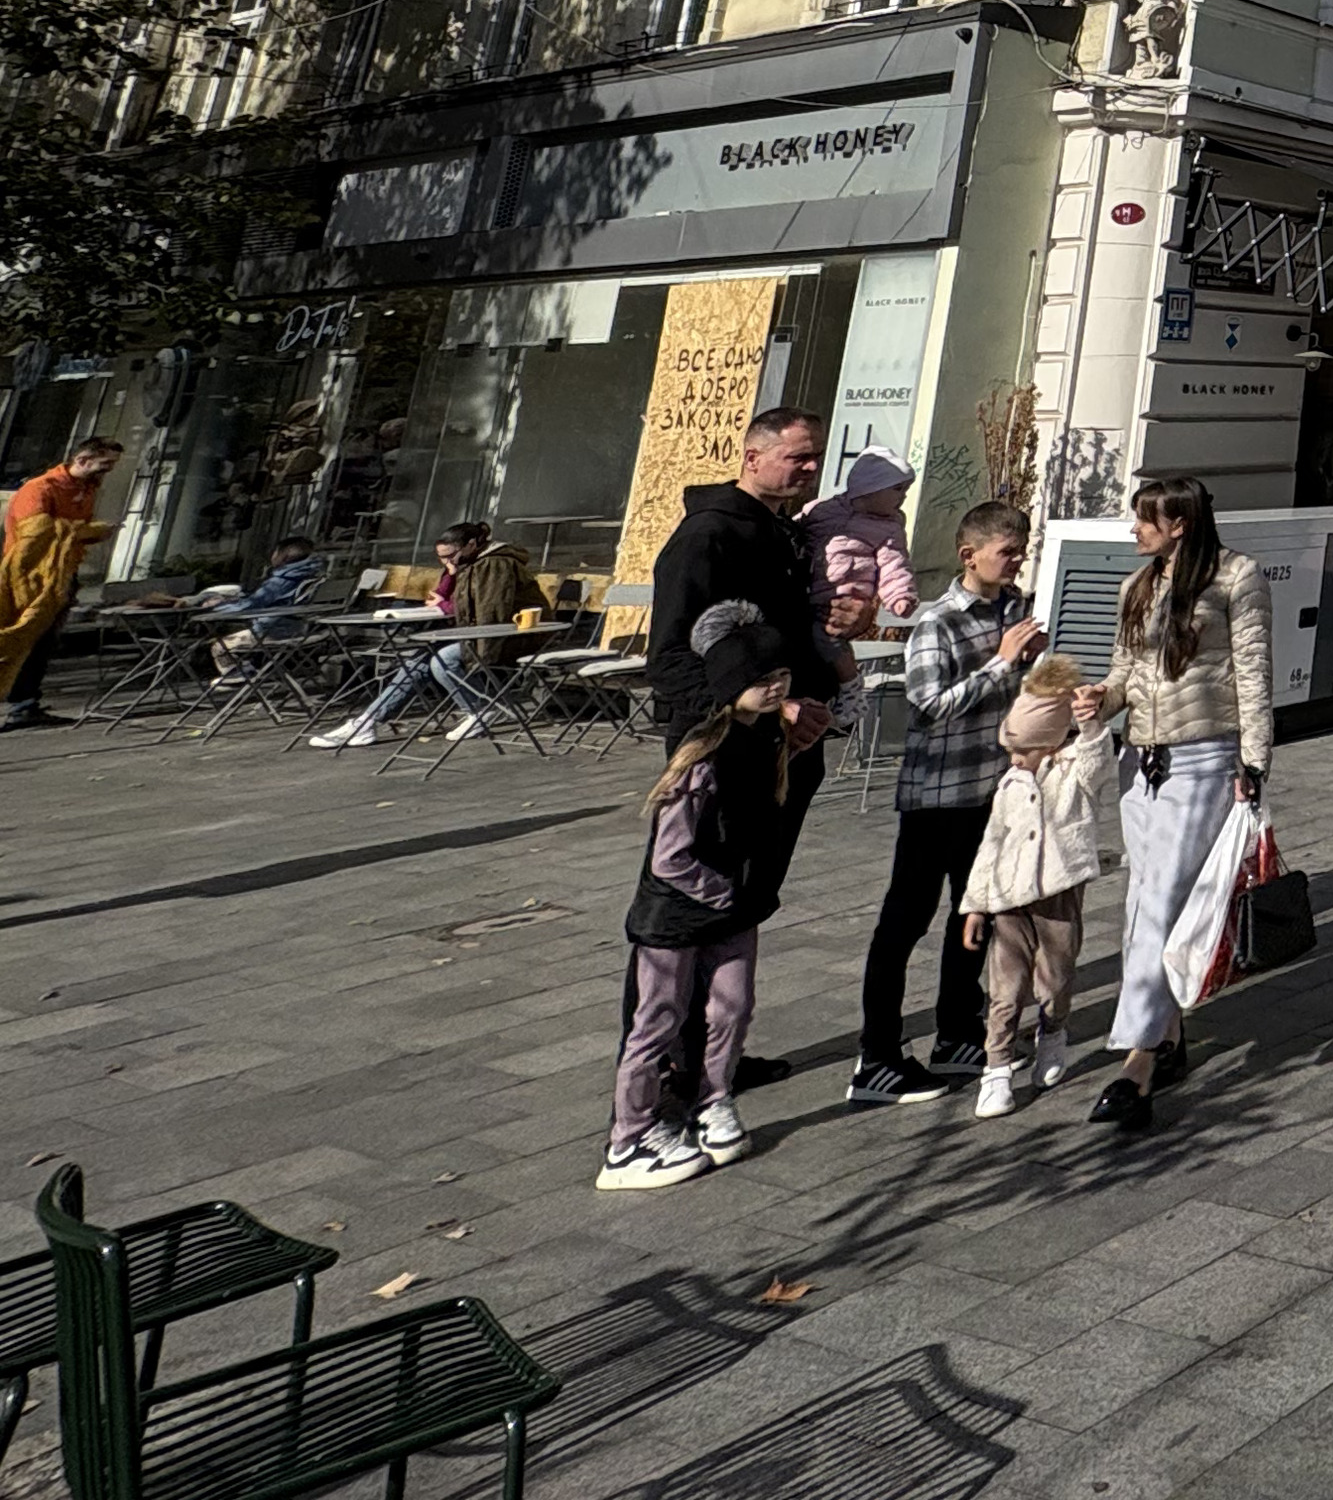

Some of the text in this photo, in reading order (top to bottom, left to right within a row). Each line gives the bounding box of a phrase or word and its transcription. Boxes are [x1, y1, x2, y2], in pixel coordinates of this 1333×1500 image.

[719, 124, 915, 168] BLACK HONEY
[677, 345, 763, 372] ВСЕ ОДНО
[681, 376, 749, 405] ДОБРО
[845, 387, 912, 400] BLACK HONEY
[1182, 384, 1275, 395] BLACK HONEY
[660, 408, 746, 431] ЗАКОХАЄ
